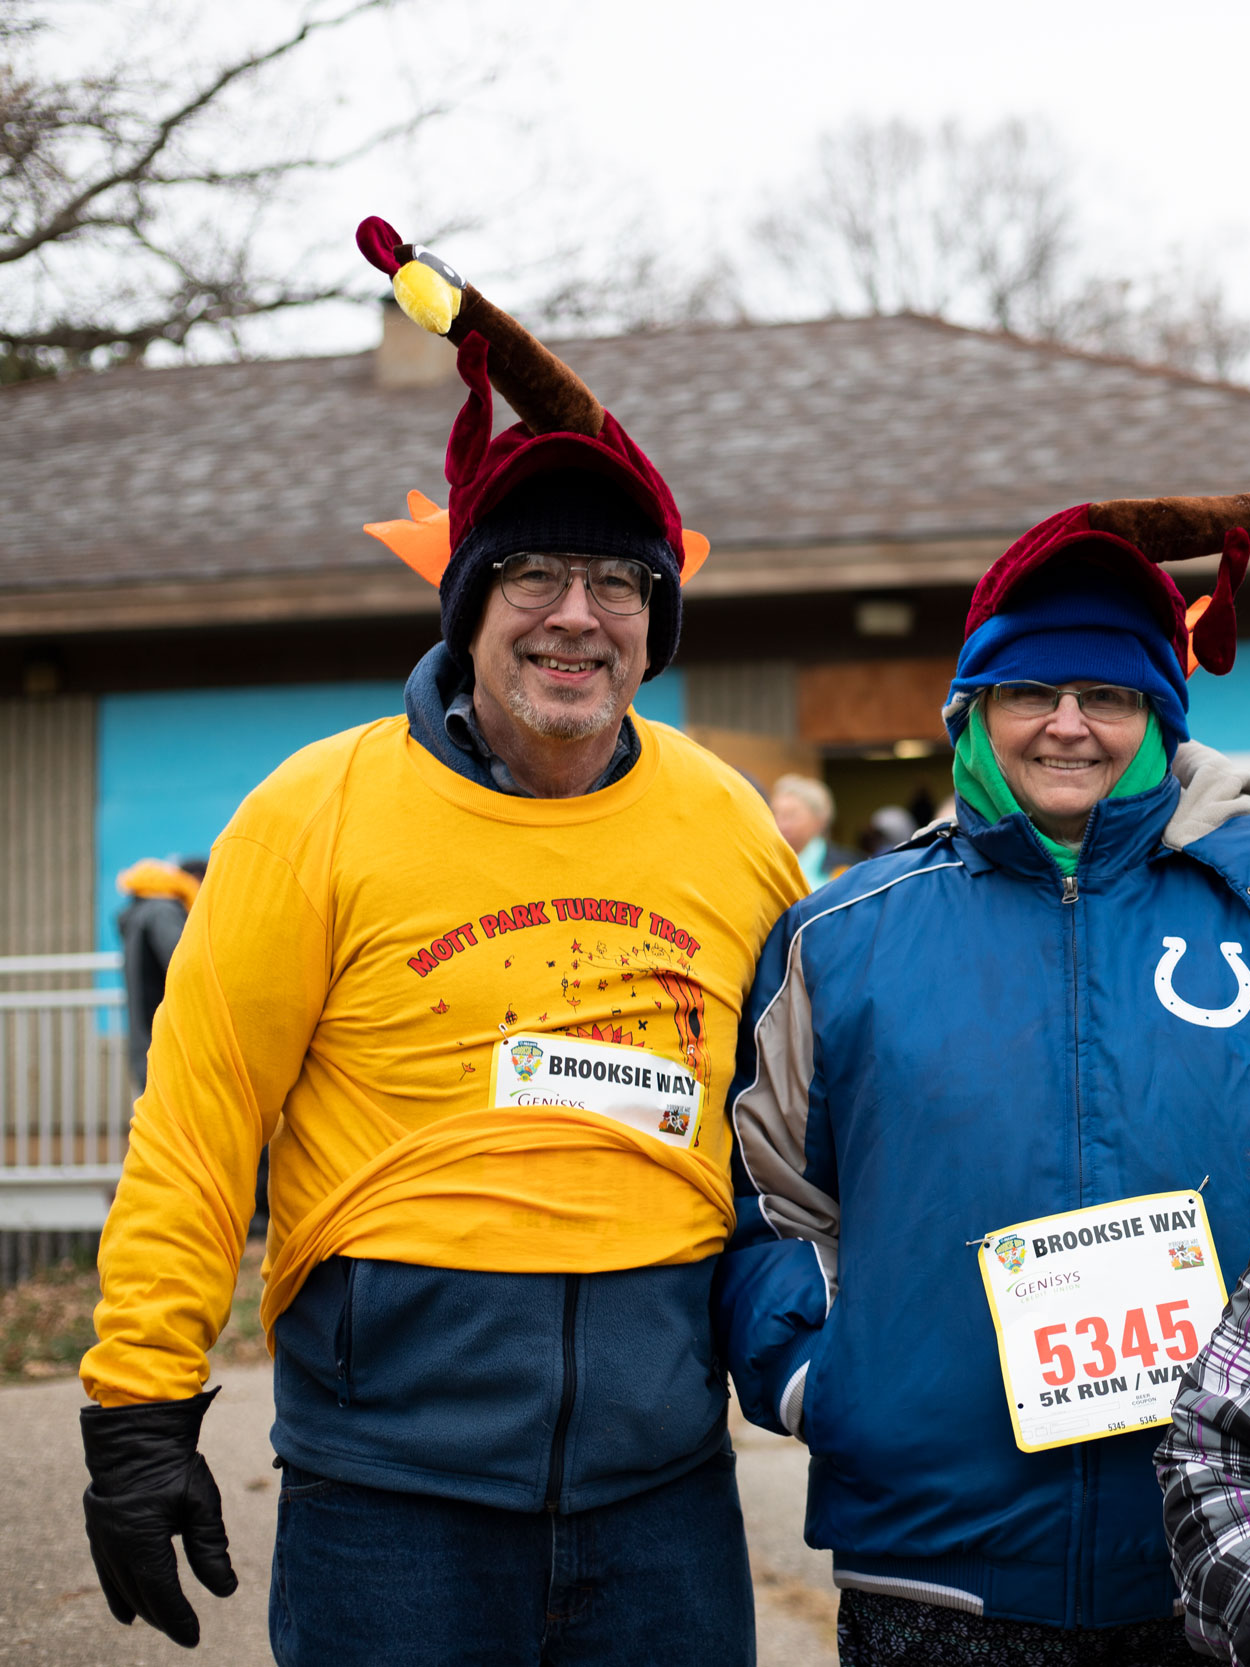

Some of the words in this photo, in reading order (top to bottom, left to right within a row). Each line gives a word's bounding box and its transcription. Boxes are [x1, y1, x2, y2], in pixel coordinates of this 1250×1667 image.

[407, 923, 478, 978] MOTT
[480, 901, 550, 938] PARK
[551, 898, 643, 927] TURKEY
[649, 912, 701, 958] TROT
[549, 1055, 652, 1089] BROOKSIE
[656, 1071, 696, 1097] WAY
[1032, 1216, 1145, 1259] BROOKSIE
[1149, 1208, 1197, 1233] WAY
[1034, 1299, 1200, 1387] 5345
[1039, 1387, 1072, 1408] 5K
[1077, 1376, 1128, 1400] RUN
[1135, 1373, 1141, 1391] /
[1147, 1362, 1193, 1385] WA
[1107, 1421, 1126, 1432] 5345
[1139, 1414, 1158, 1425] 5345
